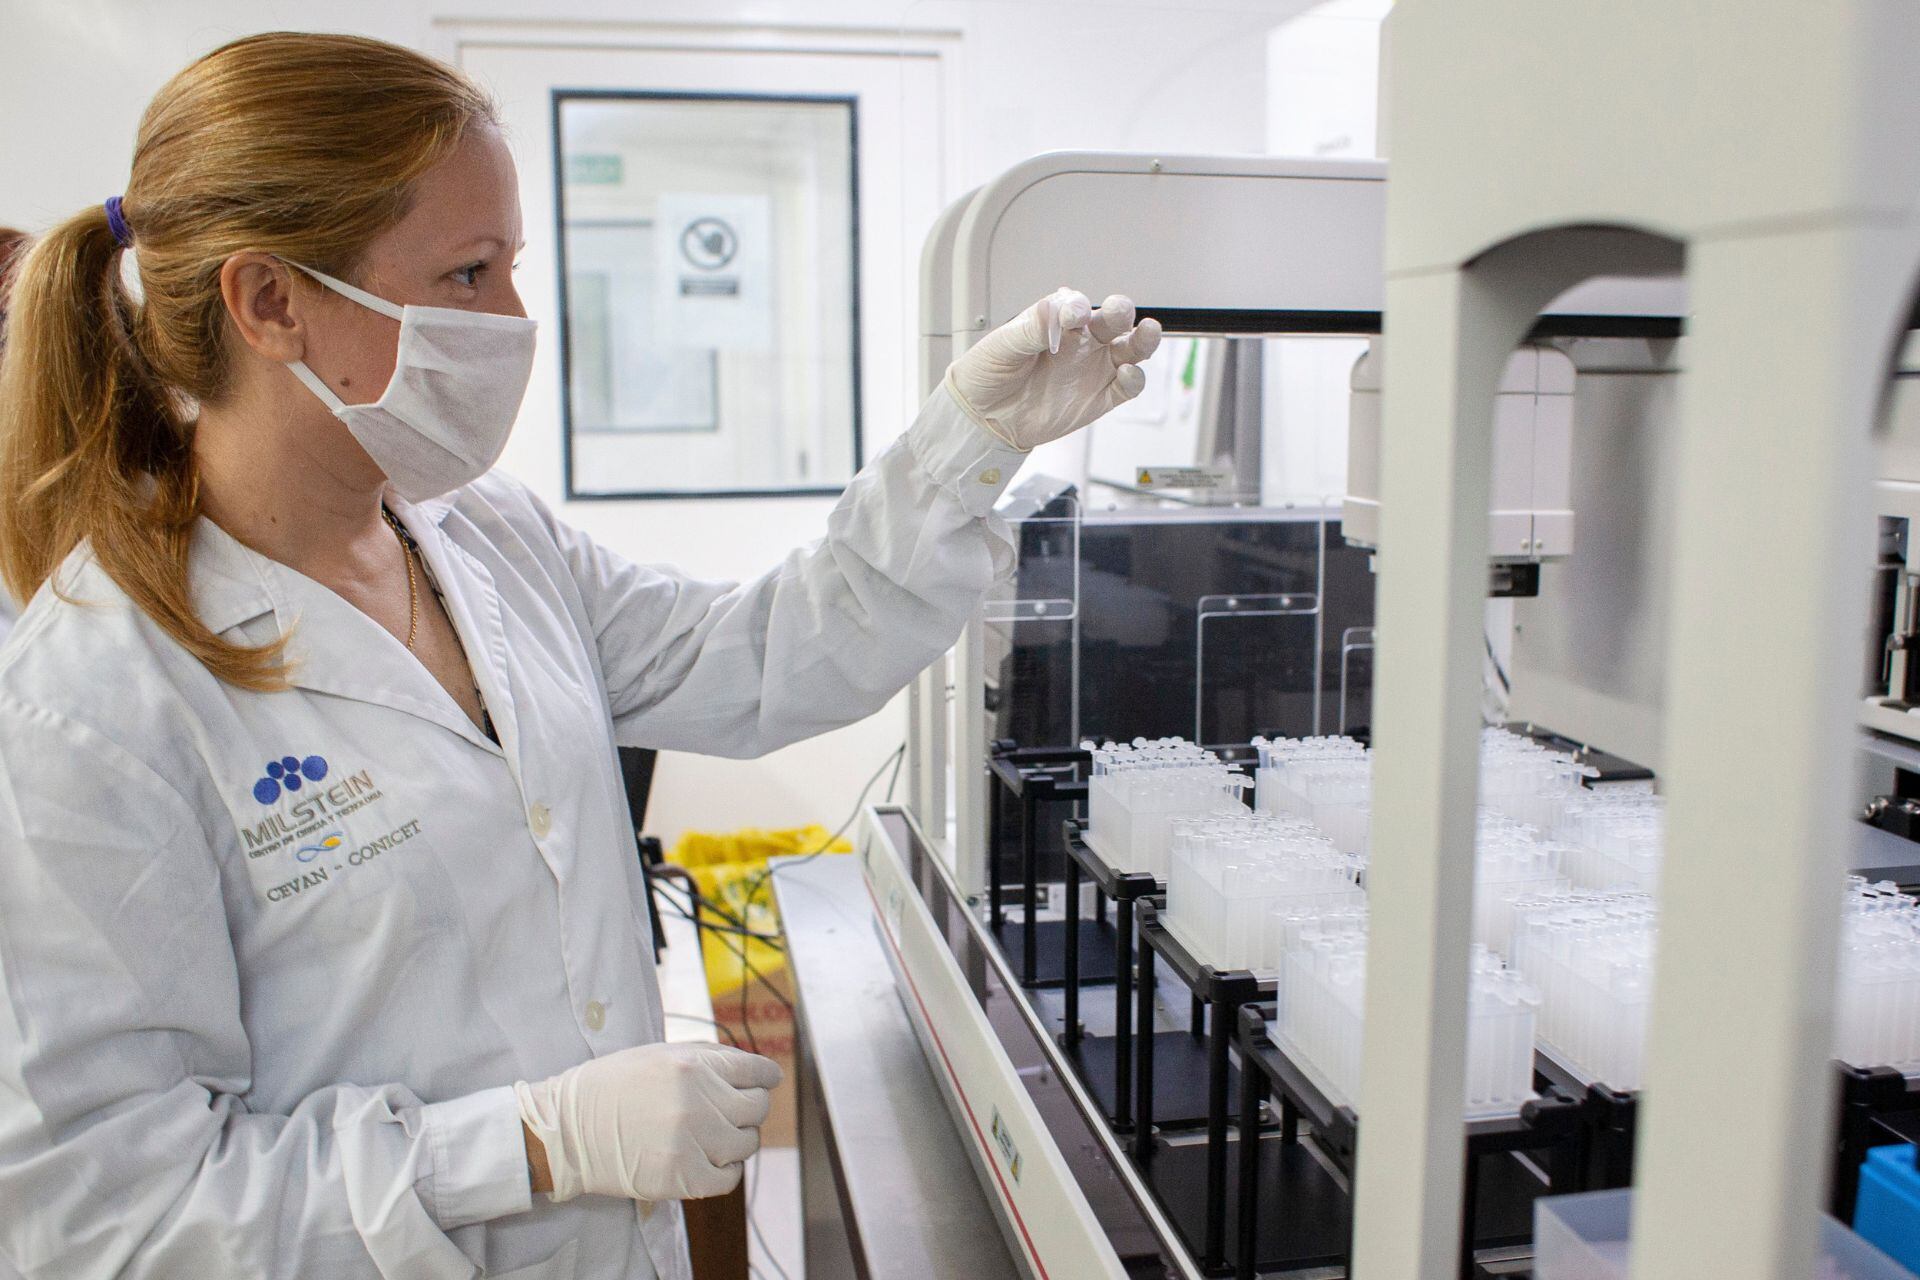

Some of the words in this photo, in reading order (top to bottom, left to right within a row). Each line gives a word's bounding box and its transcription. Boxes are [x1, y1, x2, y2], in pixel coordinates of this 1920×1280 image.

[242, 769, 375, 850] MILSTEIN
[267, 866, 329, 902] CEVAN
[348, 818, 422, 867] CONICET
